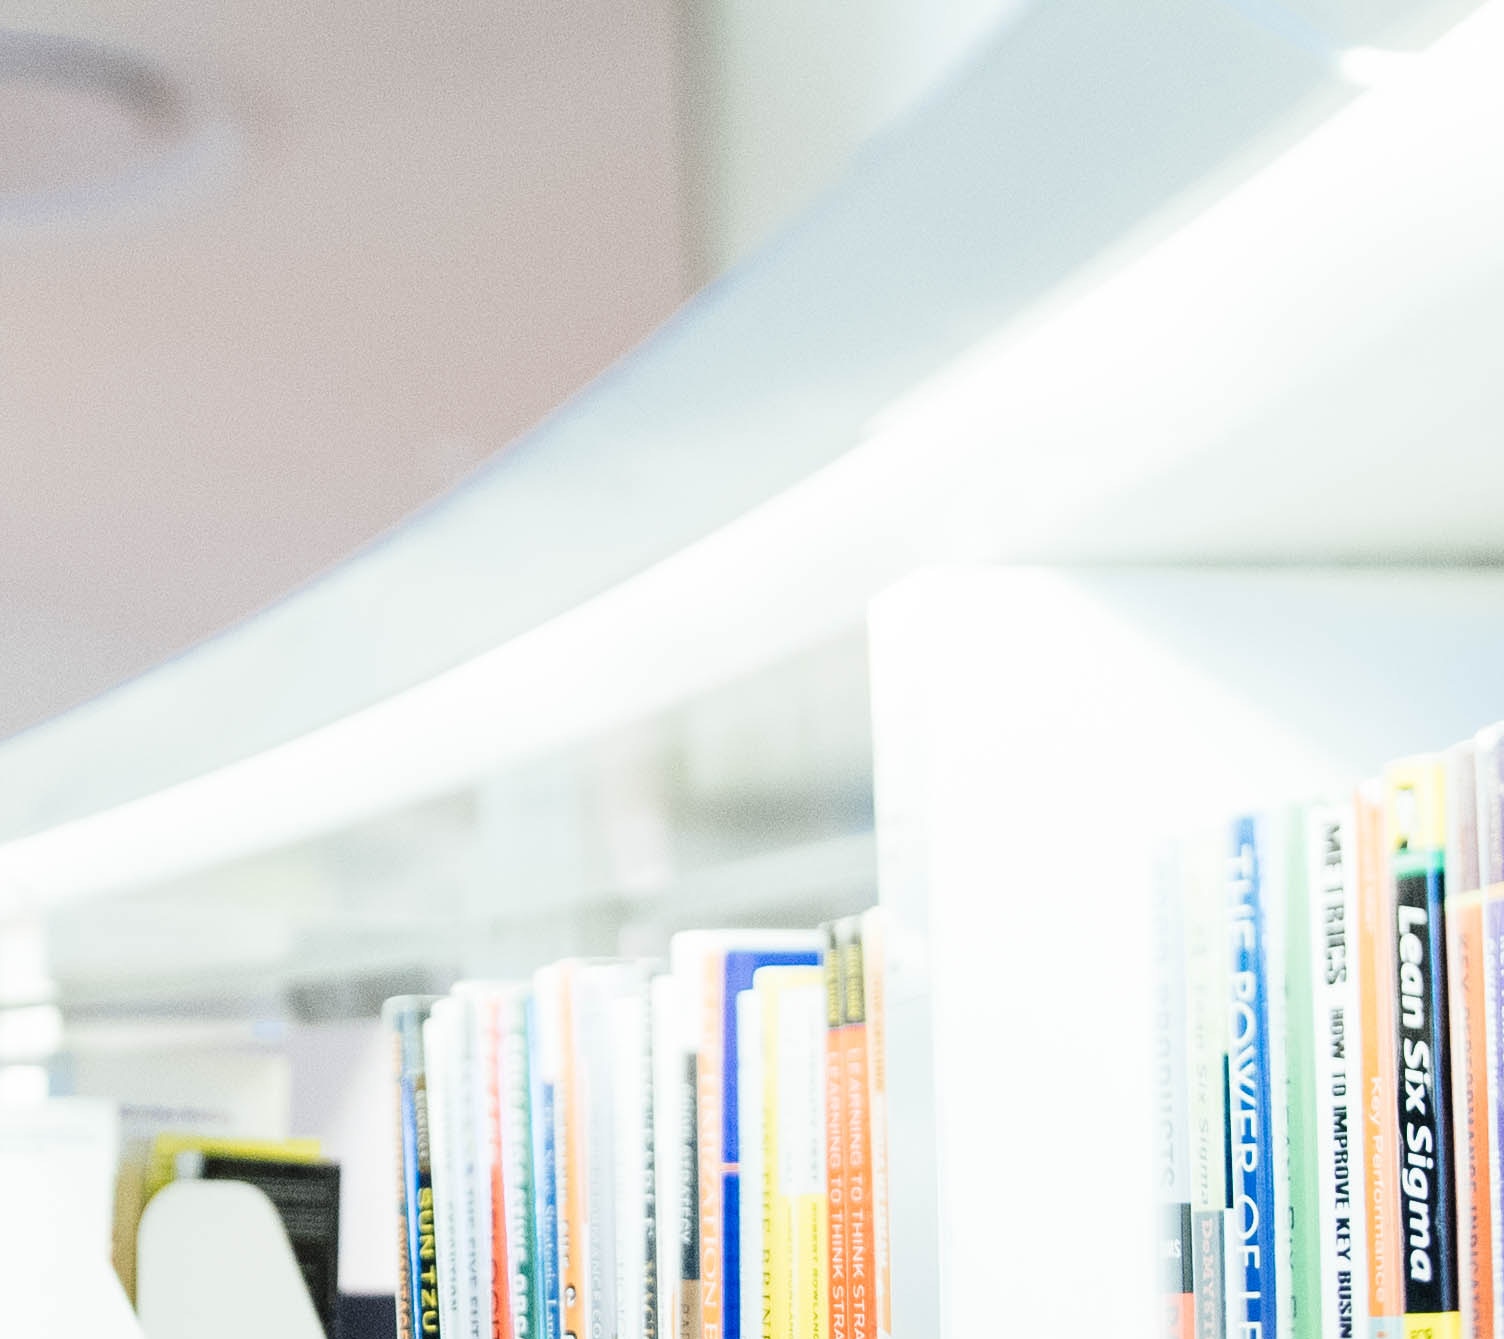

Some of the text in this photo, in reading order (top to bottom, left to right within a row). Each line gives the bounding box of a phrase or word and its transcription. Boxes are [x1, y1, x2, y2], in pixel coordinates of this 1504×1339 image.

[1329, 1007, 1346, 1059] HOW
[827, 1051, 840, 1169] LEARNING
[847, 1048, 864, 1166] LEARNING
[1331, 1072, 1348, 1098] TO
[1397, 905, 1434, 1282] Lean Six Sigma
[830, 1178, 842, 1203] TO
[850, 1175, 865, 1202] TO
[1332, 1105, 1350, 1209] IMPROVE
[1368, 1076, 1387, 1304] Key Performance
[419, 1187, 438, 1333] SUN TZU
[831, 1209, 845, 1280] THINK
[851, 1209, 868, 1279] THINK
[1335, 1217, 1353, 1261] KEY
